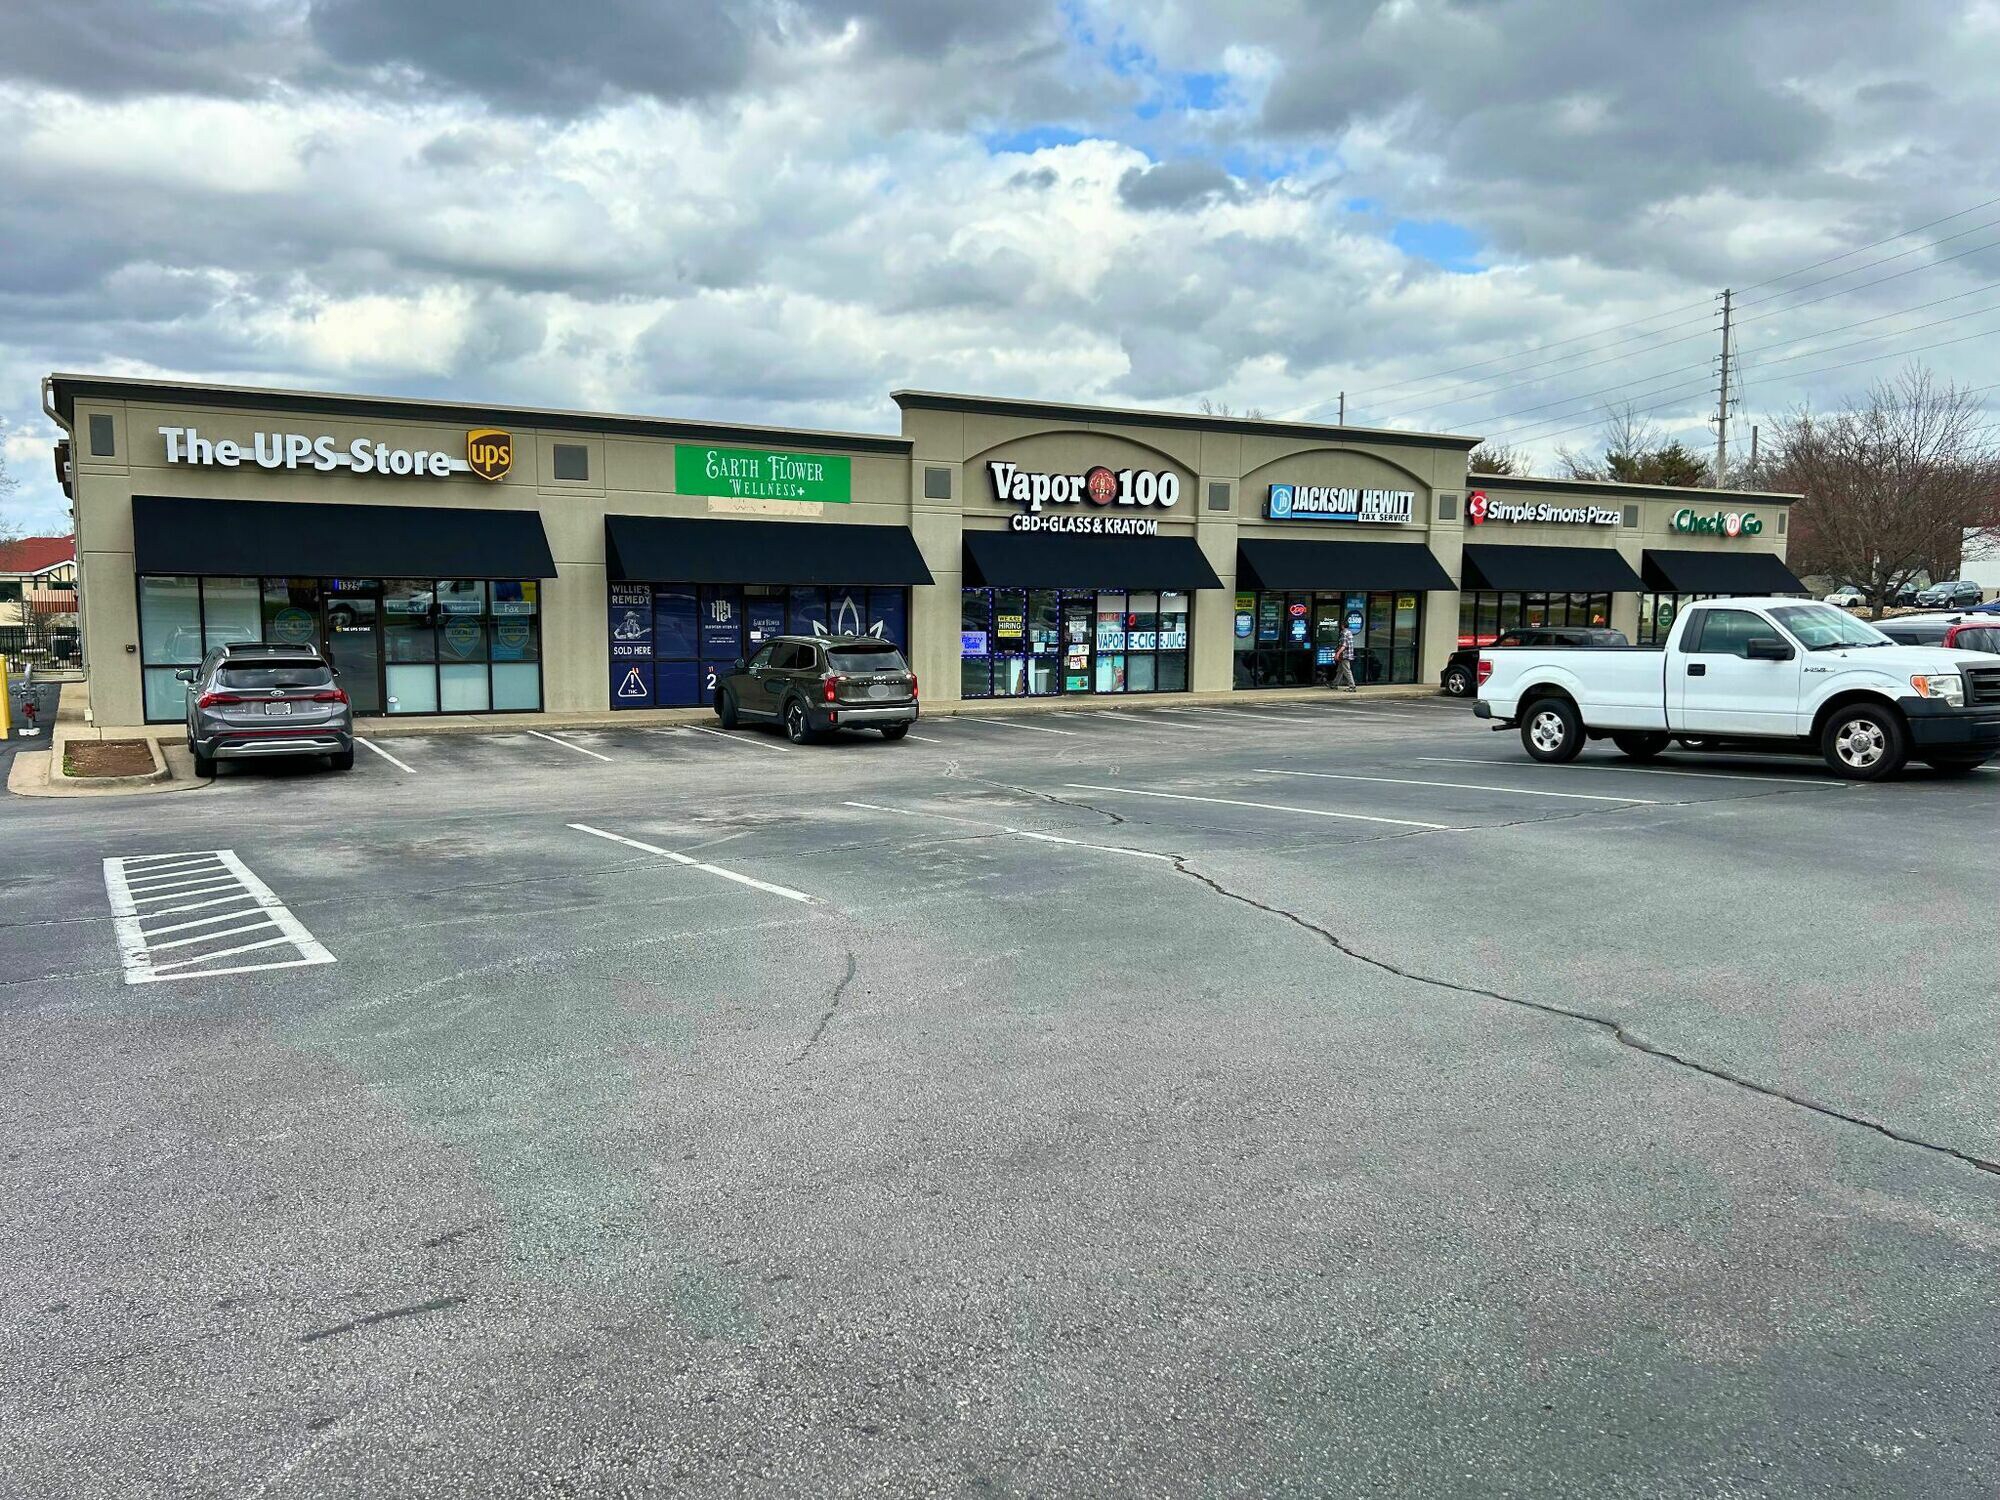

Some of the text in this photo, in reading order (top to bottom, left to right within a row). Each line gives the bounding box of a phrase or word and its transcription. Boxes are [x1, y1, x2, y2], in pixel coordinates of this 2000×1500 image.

[158, 426, 450, 477] The UPS Store
[471, 443, 510, 472] ups
[706, 451, 824, 481] EARTH FLOWER
[991, 462, 1180, 511] Vapor 100
[1292, 486, 1358, 512] JACKSON
[1361, 490, 1414, 514] HEWITT
[1379, 514, 1410, 522] SERVICE
[1488, 502, 1621, 524] Simple Simon's Pizza
[1012, 515, 1158, 535] CBD+GLASS & KRATOM
[1674, 509, 1725, 535] Check
[1740, 513, 1762, 535] Go
[611, 585, 651, 594] WILLIE'S
[611, 595, 651, 604] REMEDY
[503, 604, 519, 613] Fax
[998, 622, 1021, 630] HIRING
[1098, 633, 1124, 648] VAPOR
[1128, 633, 1156, 648] E-CIG
[1160, 633, 1186, 647] E-JUICE
[613, 646, 652, 655] SOLD HERE
